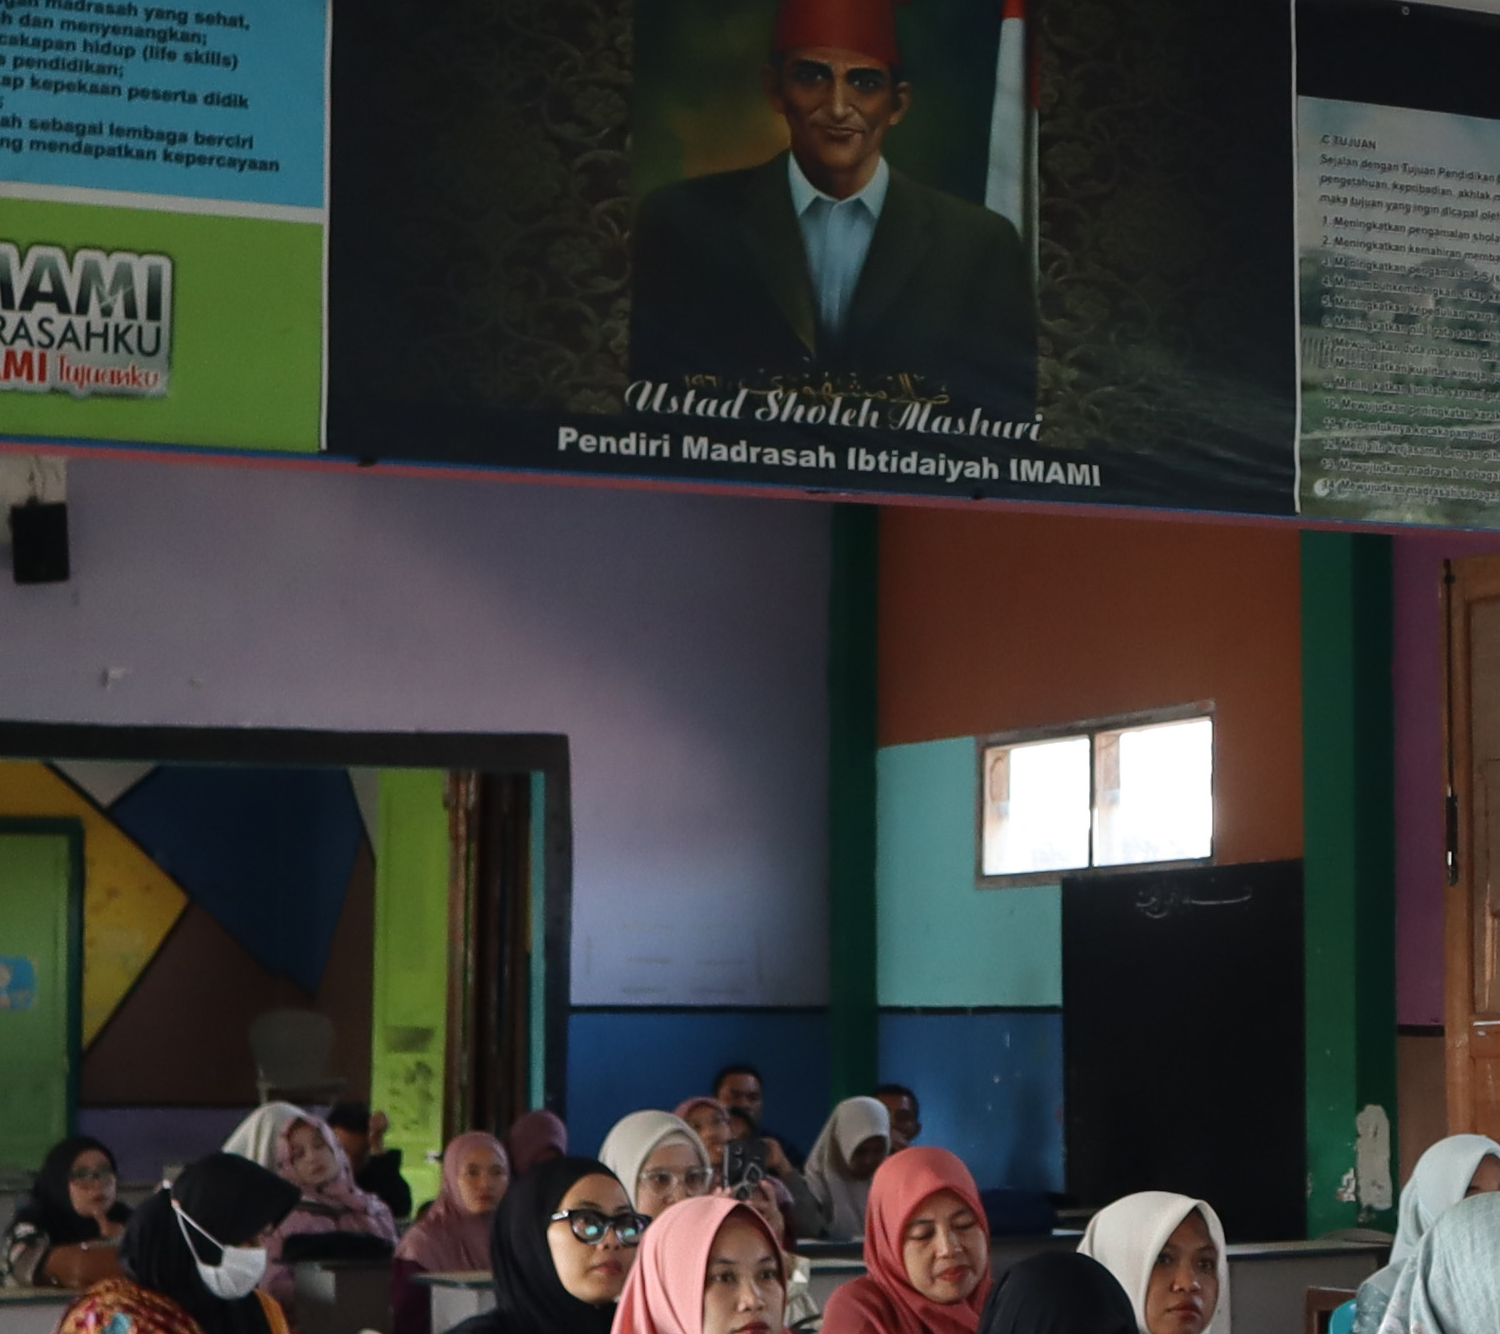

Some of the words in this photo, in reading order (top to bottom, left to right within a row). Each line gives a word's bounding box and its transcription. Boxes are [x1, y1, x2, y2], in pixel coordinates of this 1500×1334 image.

[18, 11, 53, 29] dan
[143, 7, 188, 26] yang
[81, 37, 136, 60] hidup
[141, 44, 177, 62] (life
[624, 380, 748, 420] Ustad
[755, 389, 880, 430] Sholeh
[889, 402, 1044, 442] Mashuri
[557, 426, 671, 458] Pendiri
[682, 435, 836, 468] Madrasah
[847, 447, 999, 483] Ibtidaiyah
[1010, 459, 1102, 488] IMAMI
